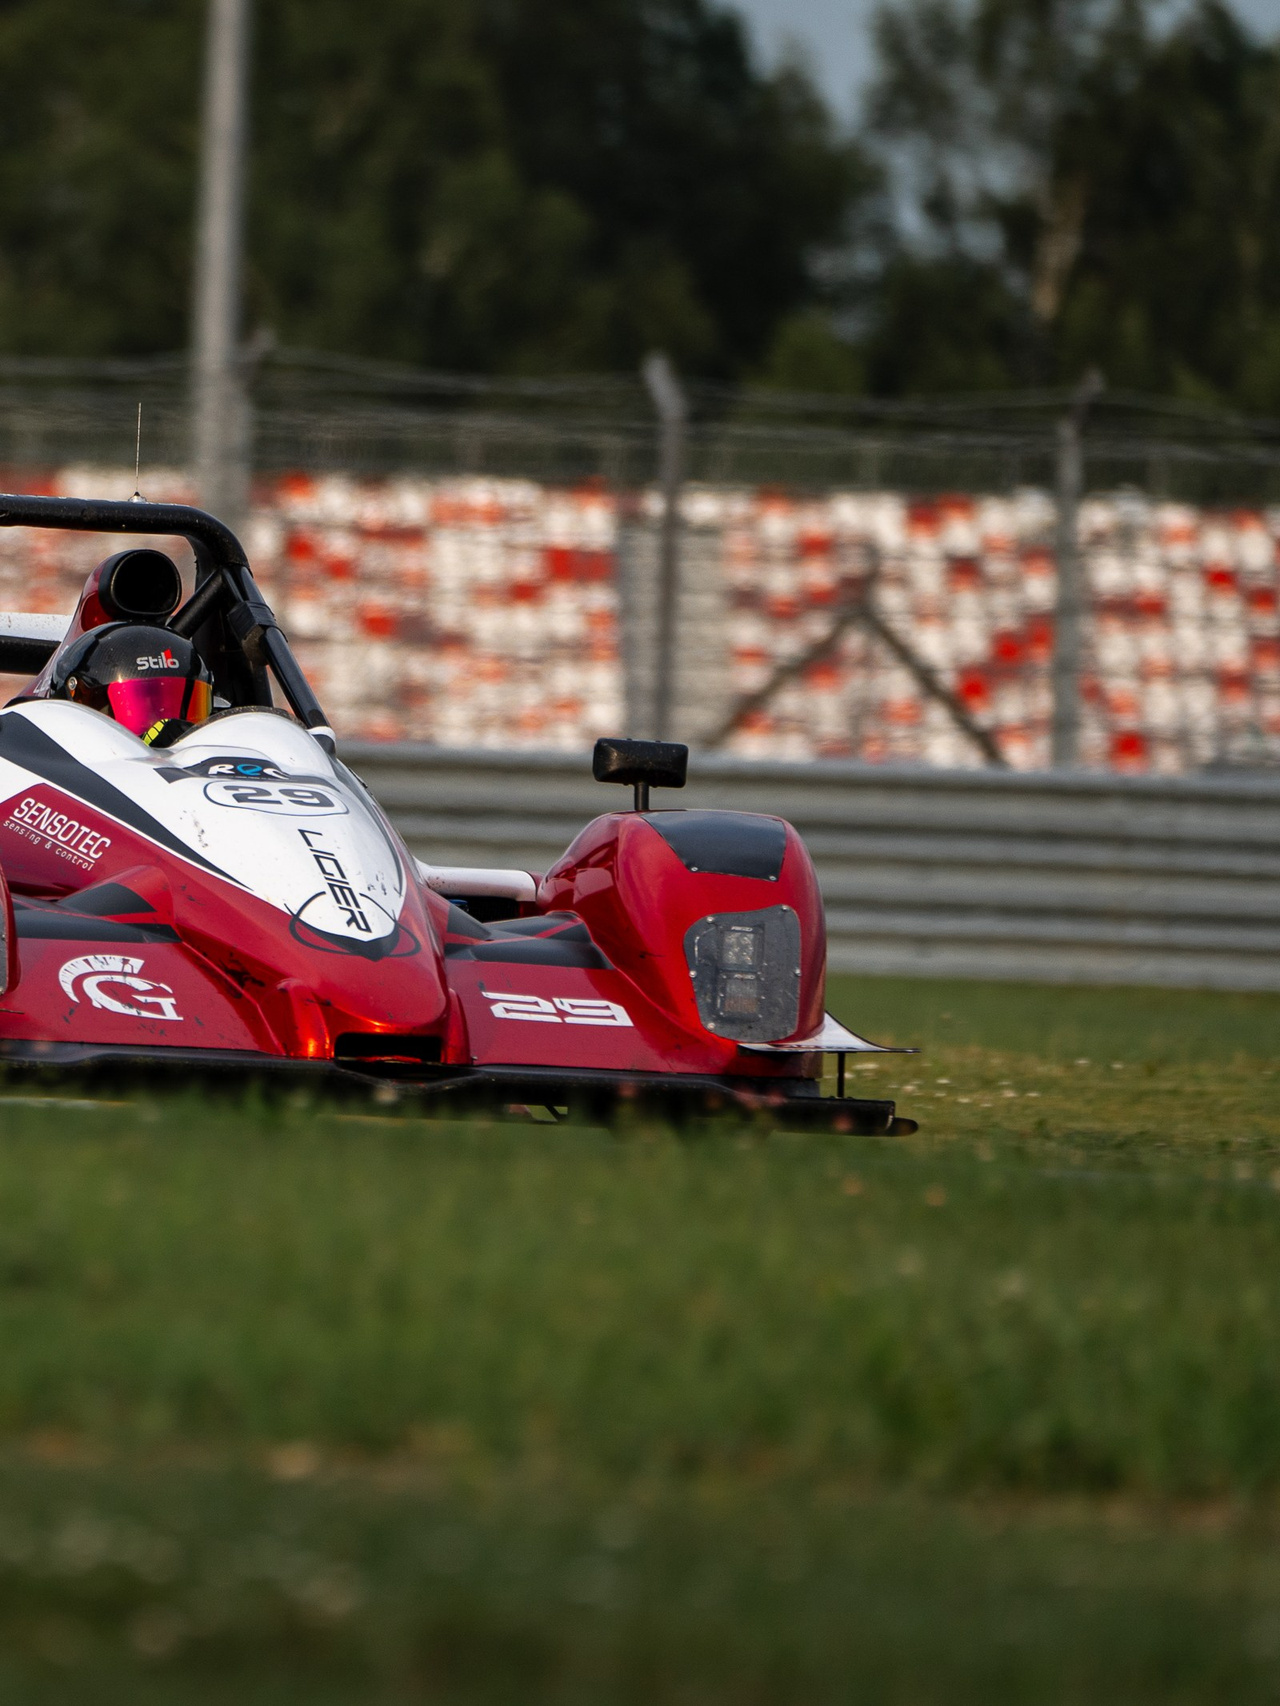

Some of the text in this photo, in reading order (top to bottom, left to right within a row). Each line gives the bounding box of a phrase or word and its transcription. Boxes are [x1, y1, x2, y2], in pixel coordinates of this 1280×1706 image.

[136, 648, 180, 671] Stilo
[222, 785, 336, 808] 29
[2, 819, 95, 872] sensing & control
[13, 797, 112, 860] SENSOTEC
[297, 828, 373, 934] LIGIER
[481, 991, 635, 1027] 29
